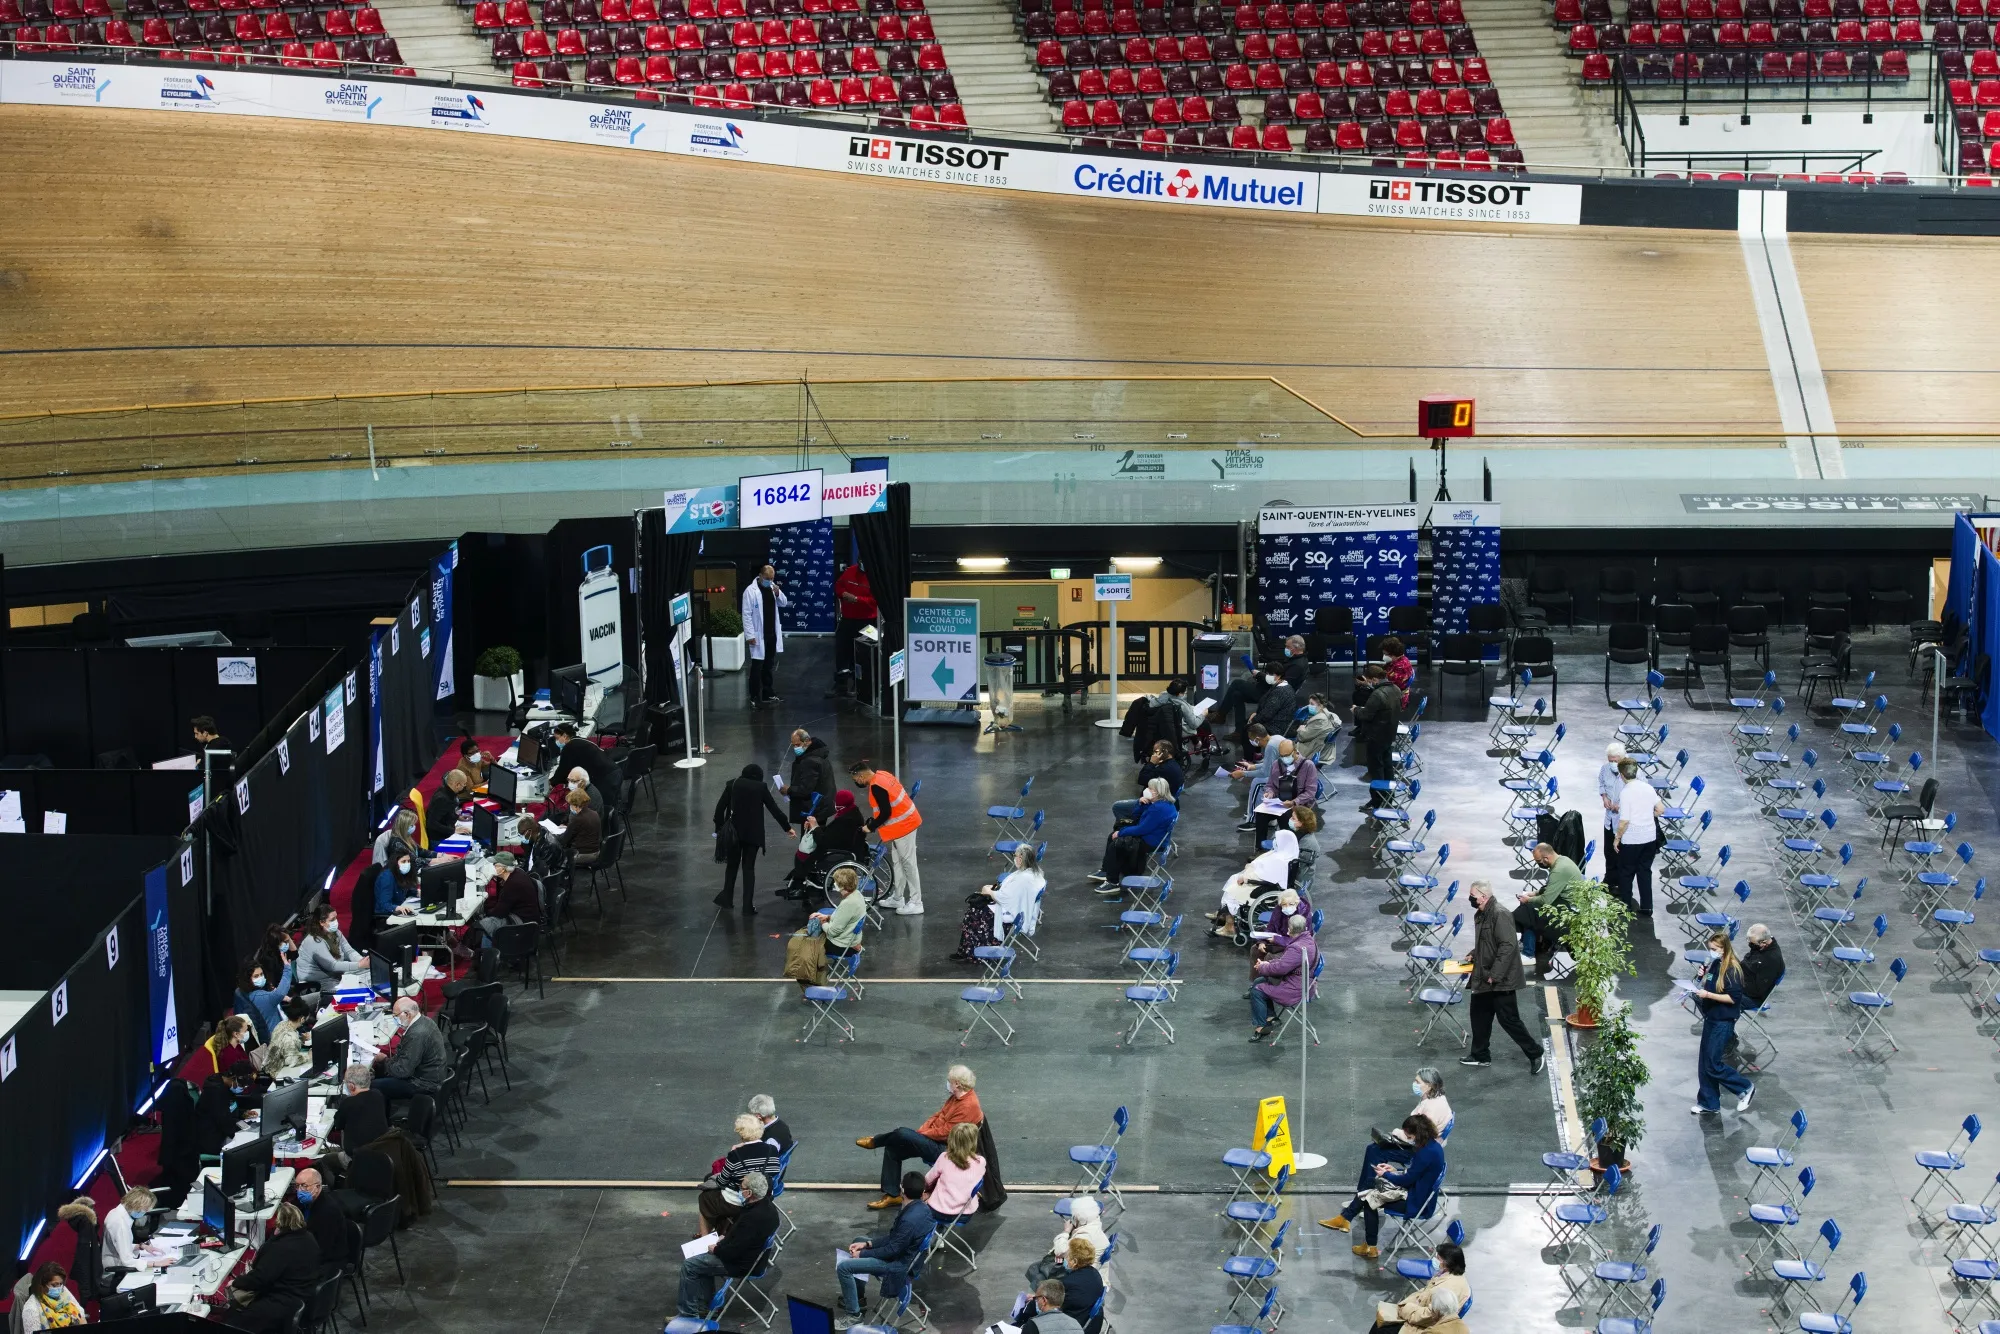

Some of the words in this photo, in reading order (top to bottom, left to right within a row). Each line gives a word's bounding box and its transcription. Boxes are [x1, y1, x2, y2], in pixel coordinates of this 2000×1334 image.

[53, 74, 96, 84] QUENTIN
[68, 67, 96, 76] SAINT
[325, 90, 367, 101] QUENTIN
[340, 84, 368, 93] SAINT
[336, 99, 367, 107] YVELINES
[589, 115, 631, 126] QUENTIN
[604, 108, 632, 119] SAINT
[600, 124, 630, 133] YVELINES
[894, 141, 1010, 171] TISSOT
[847, 160, 883, 173] SWISS
[888, 165, 940, 179] WATCHES
[946, 171, 978, 182] SINCE
[984, 175, 1007, 185] 1853
[1074, 164, 1164, 196] Crédit
[1203, 175, 1304, 206] Mutuel
[1415, 181, 1531, 206] TISSOT
[1368, 204, 1404, 214] SWISS
[1409, 206, 1463, 217] WATCHES
[1468, 208, 1501, 218] SINCE
[1507, 210, 1530, 220] 1853
[753, 483, 811, 506] 16842
[689, 500, 736, 520] STOP
[1696, 501, 1898, 510] TISSOT
[697, 517, 725, 526] COVID-19
[1262, 508, 1416, 521] SAINT-QUENTIN-EN-YVELINES
[674, 605, 685, 617] SORTIE
[918, 608, 952, 616] CENTRE
[955, 609, 966, 617] DE
[913, 616, 972, 624] VACCINATION
[589, 622, 616, 642] VACCIN
[929, 624, 956, 632] COVID
[914, 640, 972, 654] SORTIE
[348, 675, 356, 701] 15
[311, 711, 319, 738] 14
[279, 744, 288, 773] 13
[238, 783, 249, 810] 12
[183, 851, 192, 880] 11
[110, 934, 116, 962] 9
[56, 989, 63, 1017] 8
[4, 1041, 12, 1073] 7
